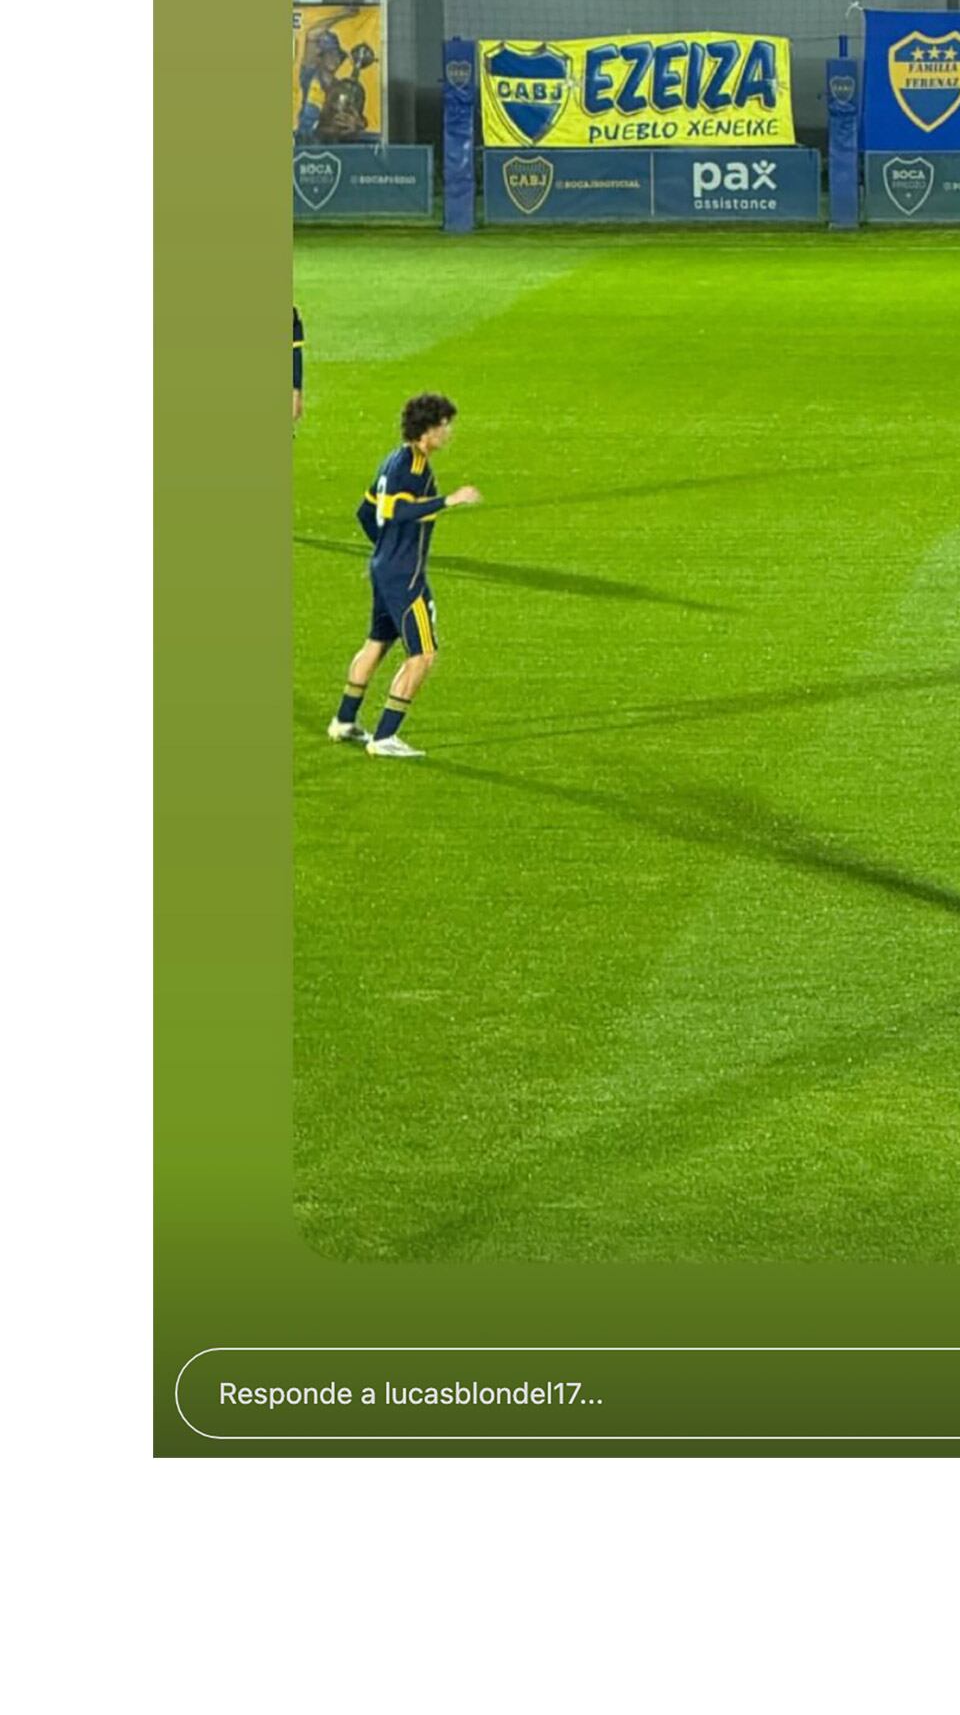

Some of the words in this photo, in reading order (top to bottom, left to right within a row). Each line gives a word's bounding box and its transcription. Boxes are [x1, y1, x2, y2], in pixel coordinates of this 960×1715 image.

[581, 39, 778, 116] EZEIZA
[496, 80, 563, 102] CABJ
[589, 120, 678, 143] PUEBLO
[687, 118, 779, 137] XENEIXE
[509, 174, 547, 187] CABJ
[692, 159, 777, 198] pax
[892, 169, 926, 180] BOCA
[695, 199, 777, 210] assistance
